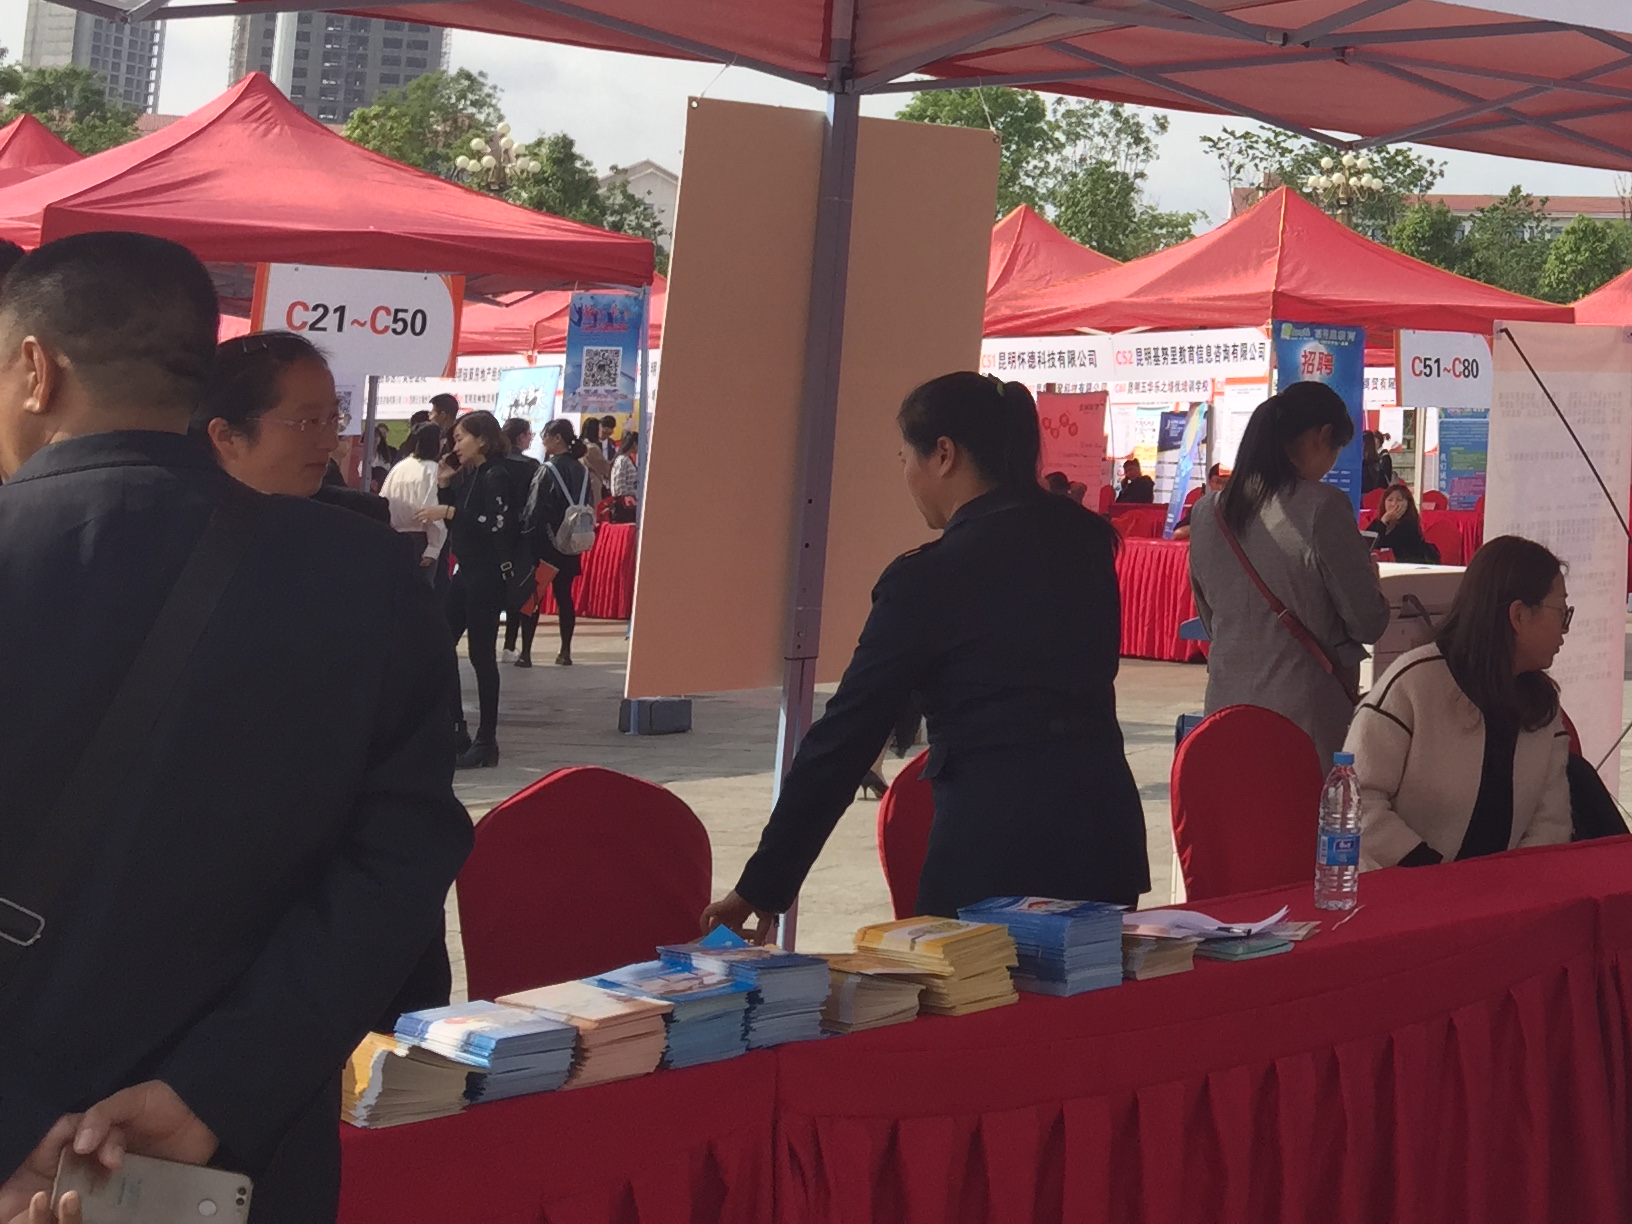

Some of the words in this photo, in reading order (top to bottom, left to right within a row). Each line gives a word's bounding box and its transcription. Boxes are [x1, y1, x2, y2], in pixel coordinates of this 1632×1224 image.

[285, 301, 427, 336] C21~C50
[998, 349, 1098, 370] 昆明怀德科技有限公司
[1115, 350, 1133, 365] C52
[1301, 350, 1335, 376] 招聘
[1411, 356, 1480, 378] C51~C80
